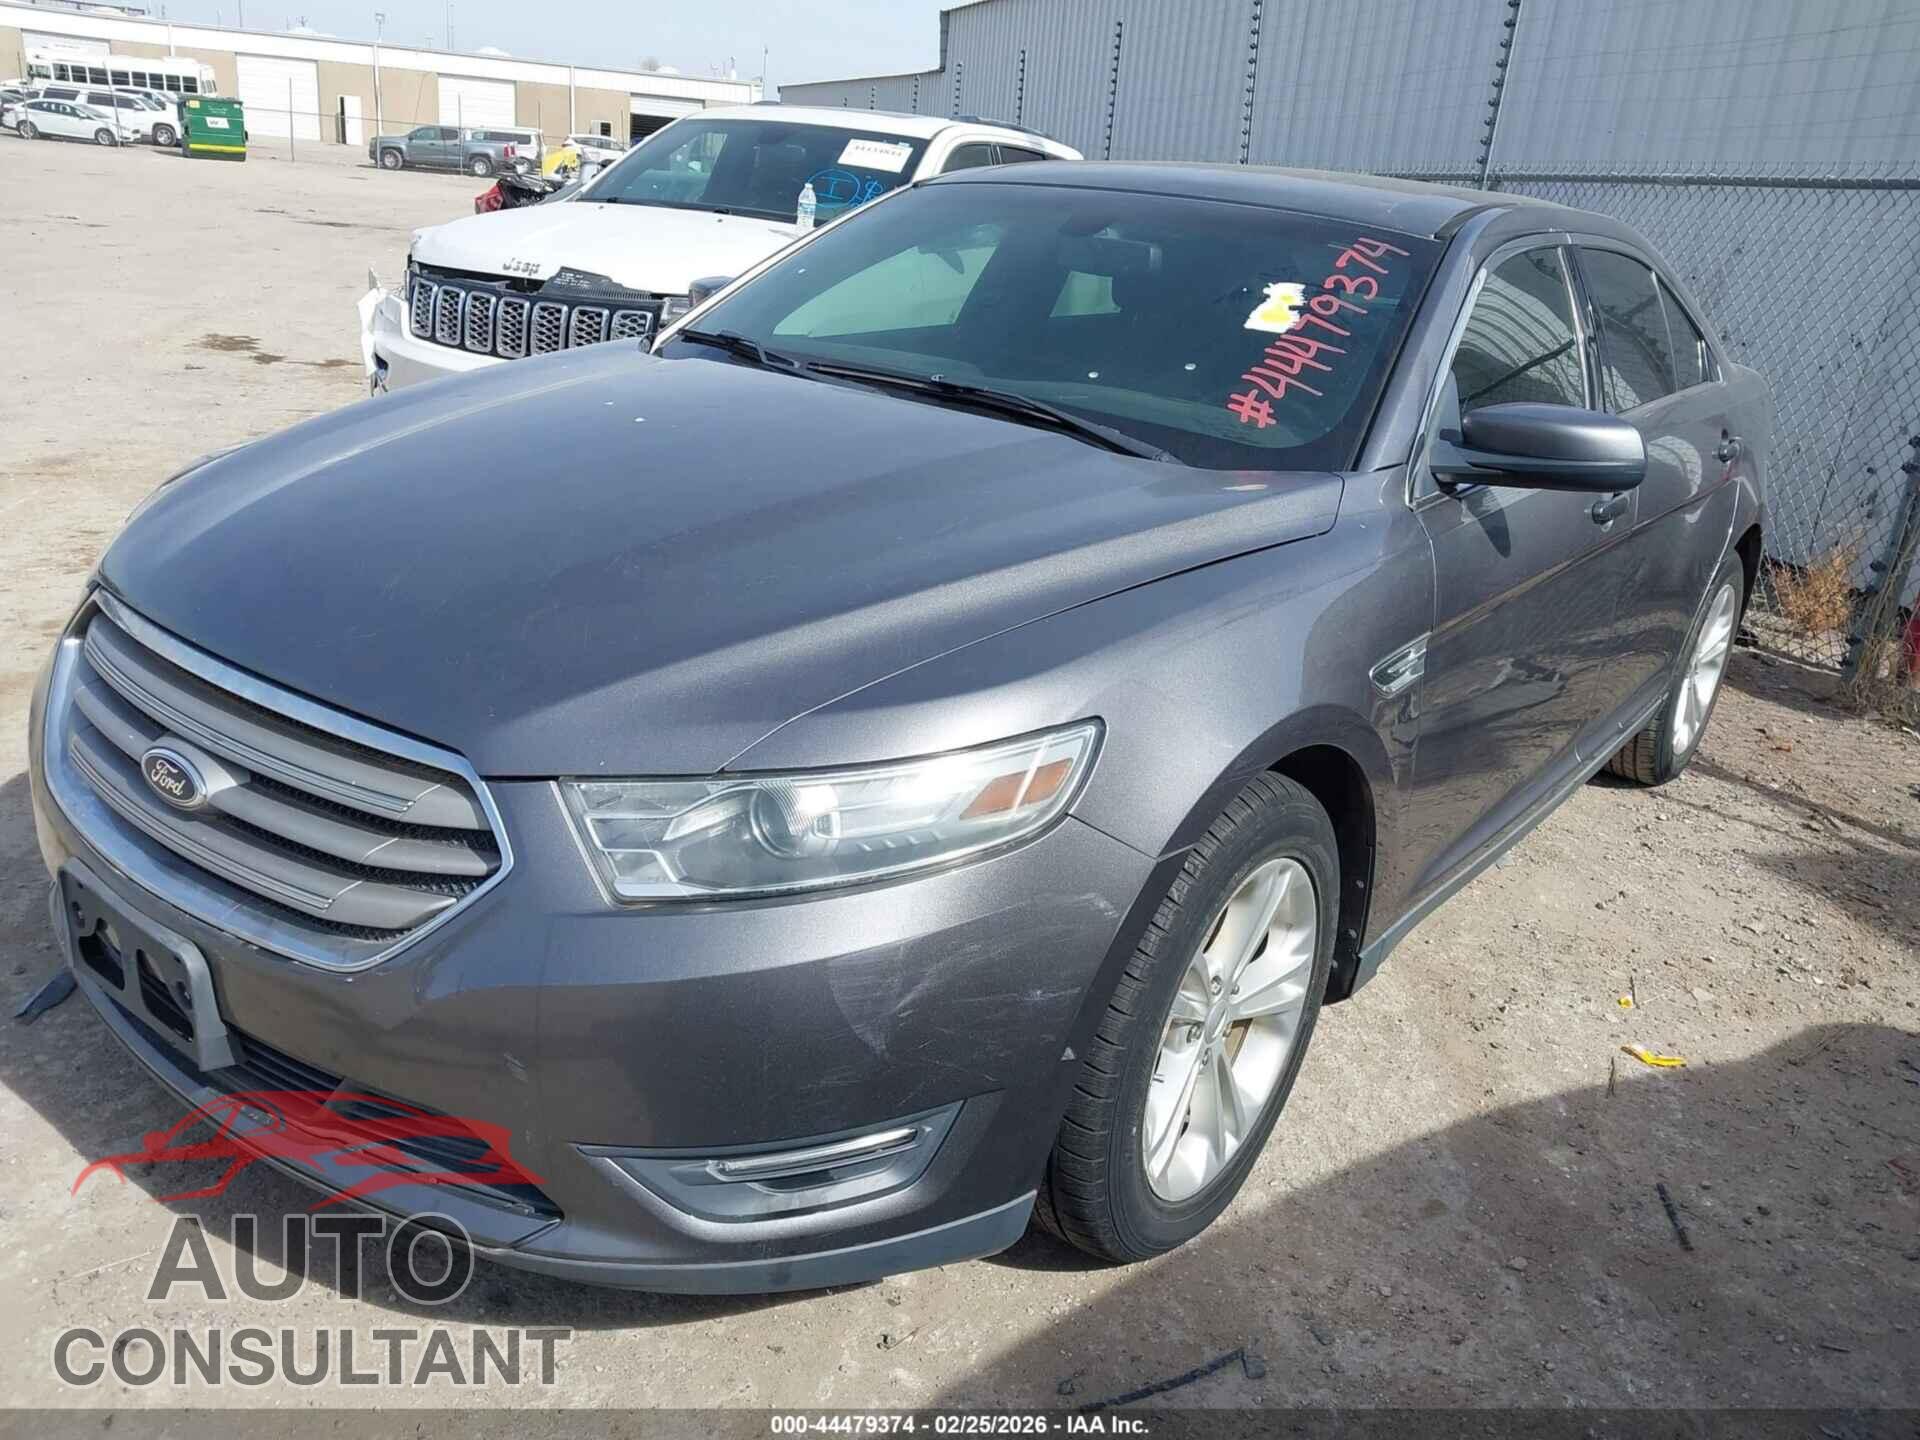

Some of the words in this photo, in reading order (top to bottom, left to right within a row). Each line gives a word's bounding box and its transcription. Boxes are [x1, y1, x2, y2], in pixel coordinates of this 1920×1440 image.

[502, 257, 541, 276] Jeep
[1227, 237, 1411, 428] #44479374
[151, 759, 186, 796] Ford
